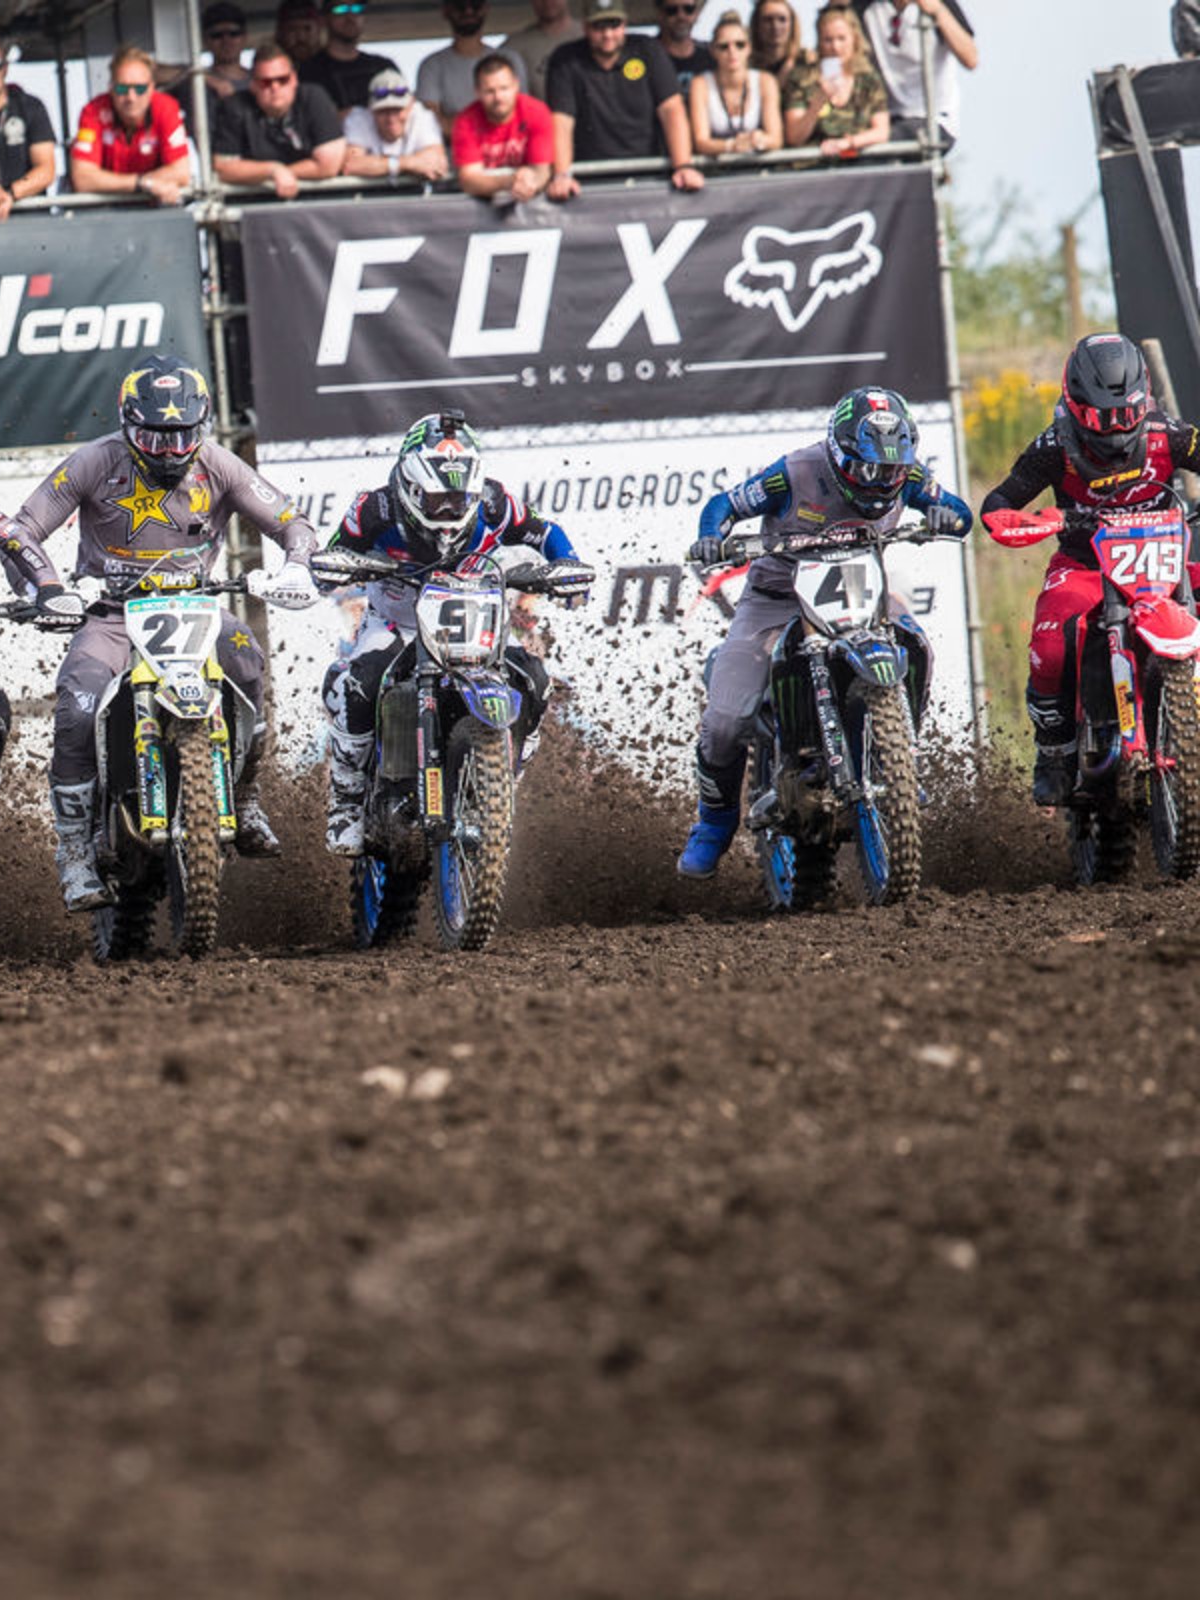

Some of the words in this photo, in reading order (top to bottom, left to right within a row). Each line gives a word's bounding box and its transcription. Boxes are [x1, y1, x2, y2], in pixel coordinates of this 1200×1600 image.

[316, 218, 708, 366] FOX
[521, 358, 683, 388] SKYBOX
[522, 467, 728, 514] MOTOCROSS
[814, 563, 873, 609] 4
[1111, 541, 1184, 586] 243
[142, 613, 213, 656] 27
[436, 599, 498, 644] 91
